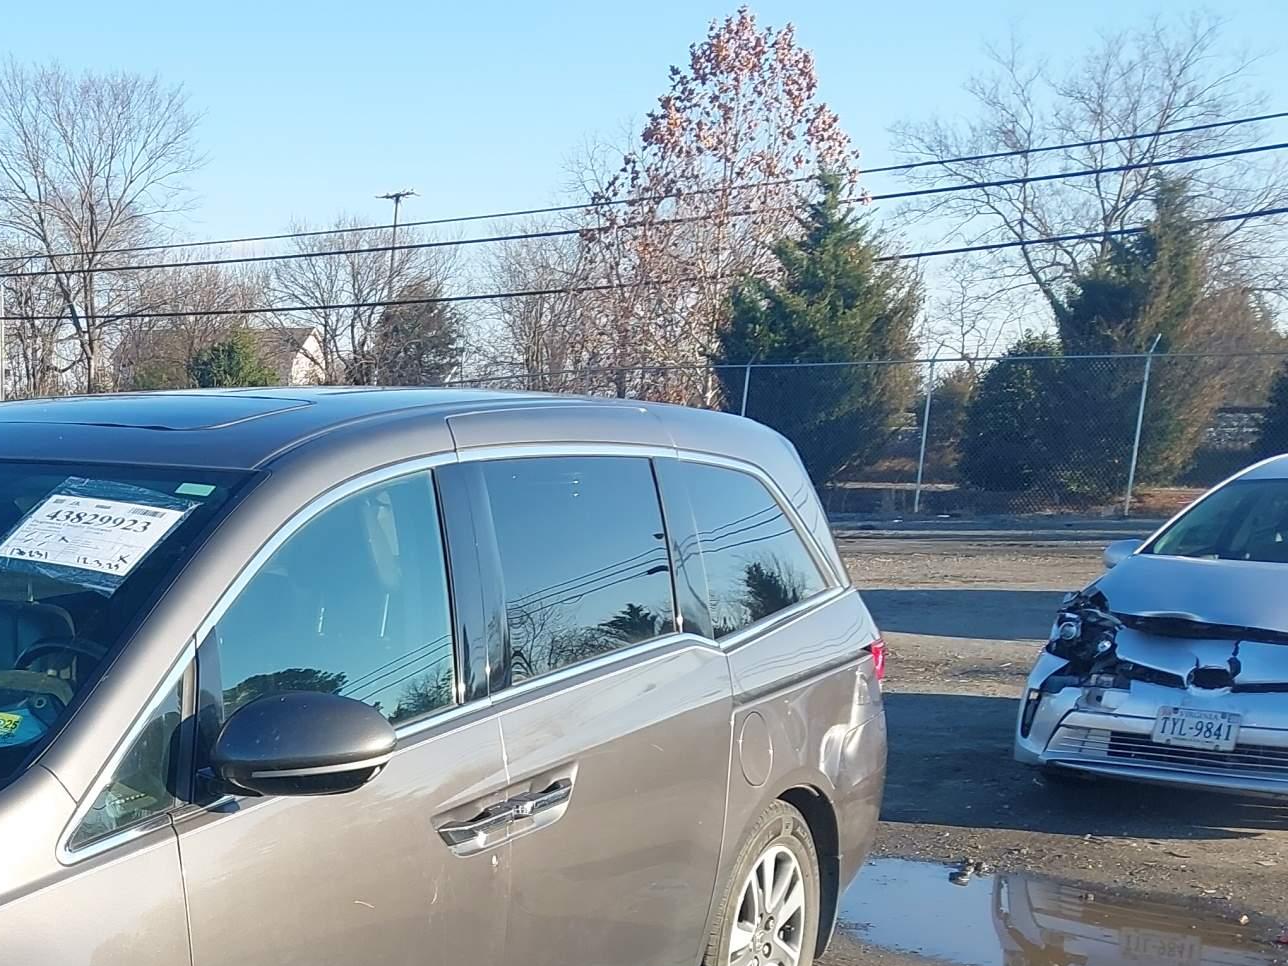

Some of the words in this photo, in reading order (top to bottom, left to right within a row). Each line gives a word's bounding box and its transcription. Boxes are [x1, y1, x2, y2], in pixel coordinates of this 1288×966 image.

[46, 508, 151, 533] 43829923
[4, 719, 20, 730] 25
[1160, 716, 1232, 741] TYL-9841
